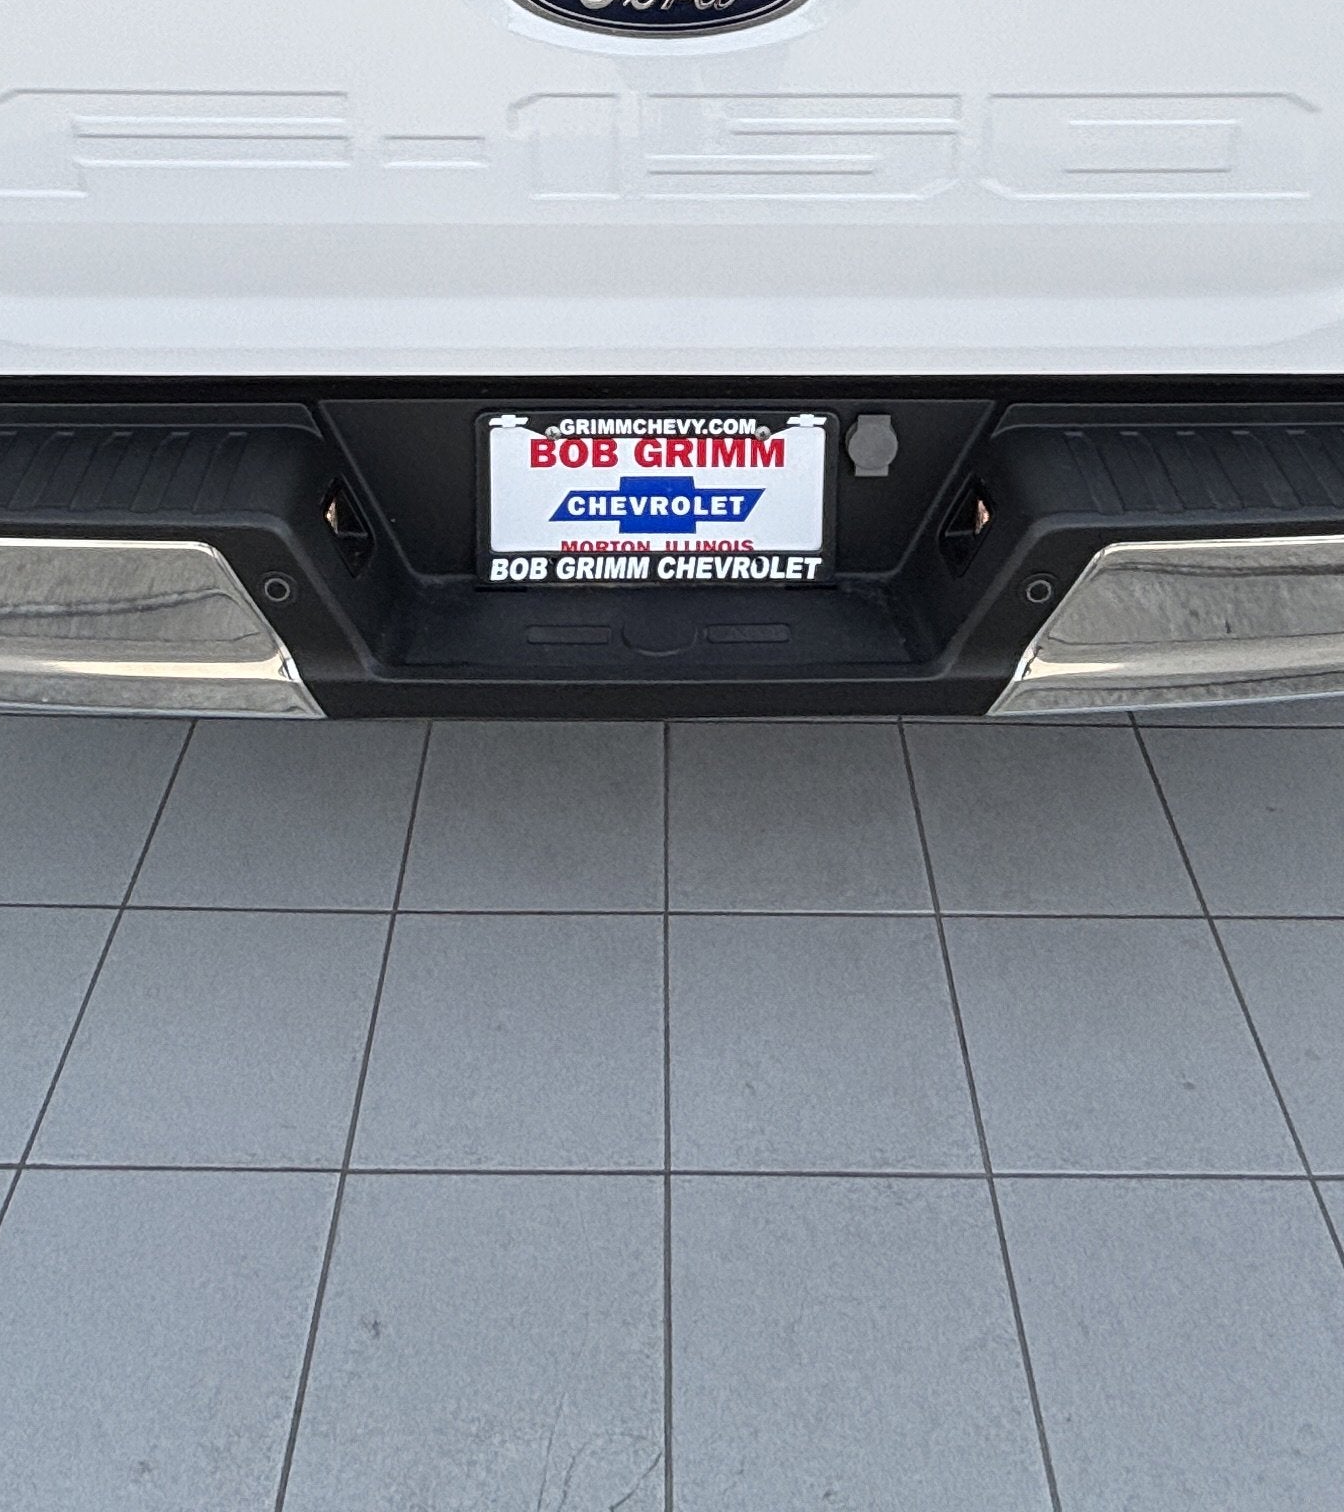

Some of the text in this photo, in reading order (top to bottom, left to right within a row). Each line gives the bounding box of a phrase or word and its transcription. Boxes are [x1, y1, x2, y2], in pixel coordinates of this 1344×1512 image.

[560, 418, 756, 436] GRIMMCHEVY.COM
[530, 438, 784, 468] BOB GRIMM
[567, 496, 745, 516] CHEVROLET
[490, 556, 822, 581] BOB GRIMM CHEVROLET
